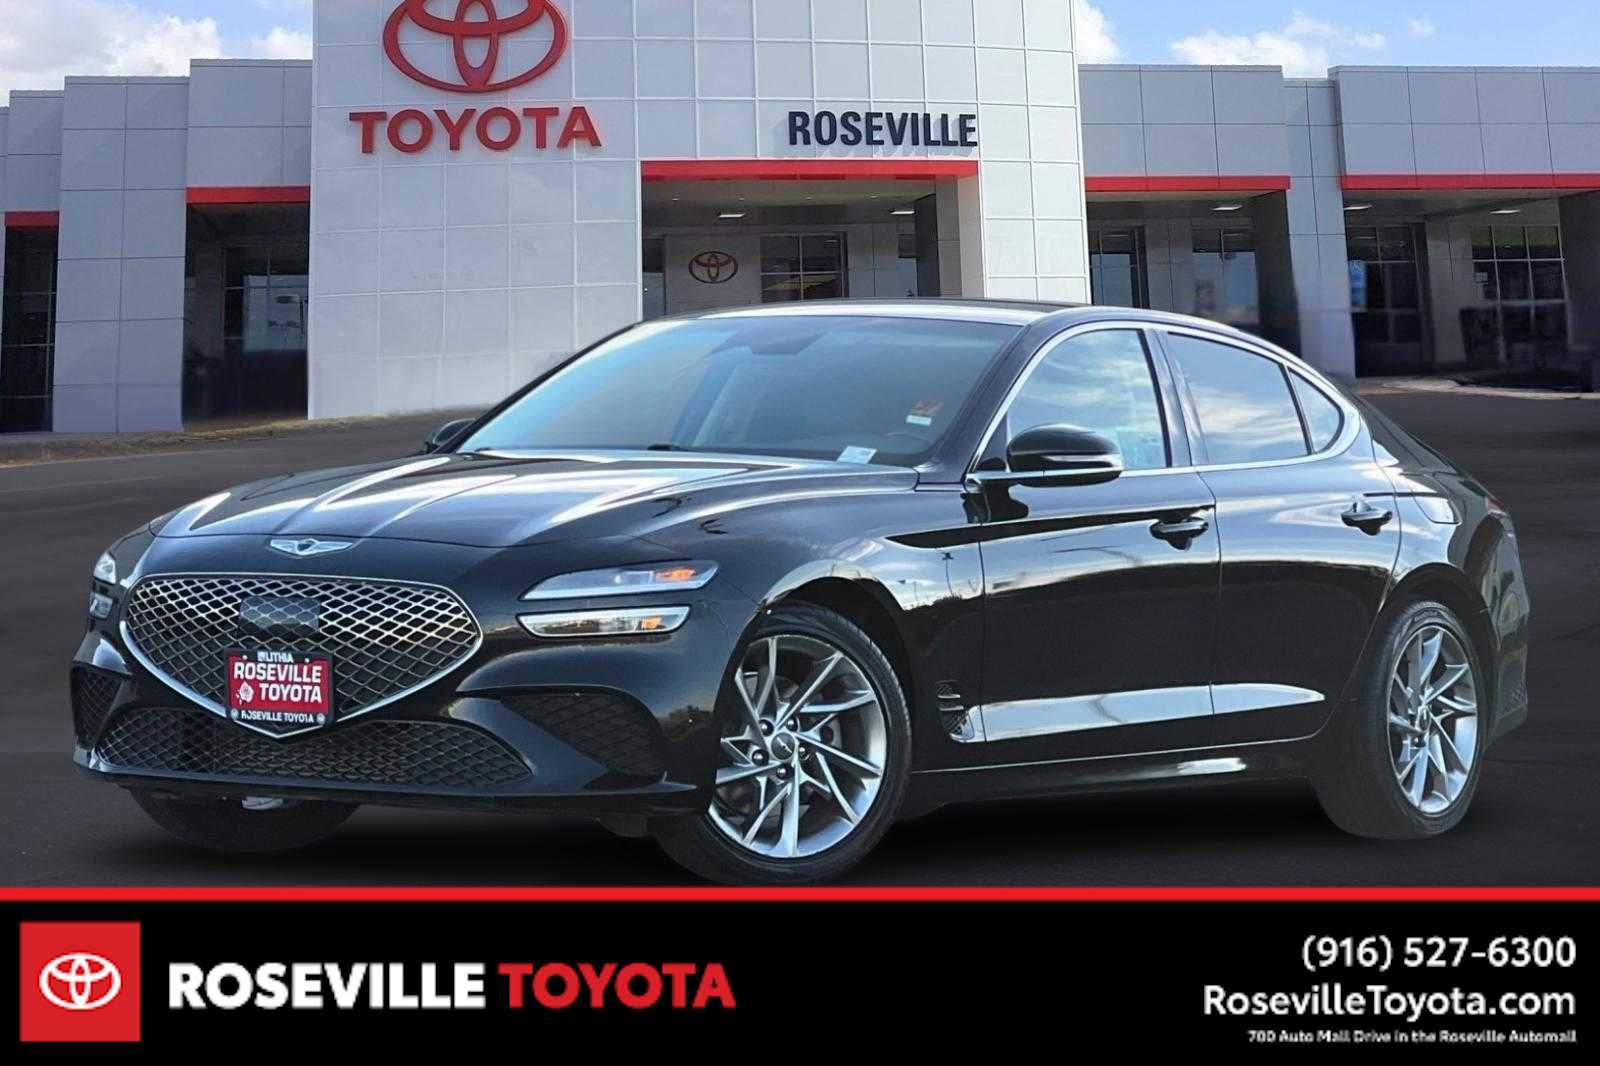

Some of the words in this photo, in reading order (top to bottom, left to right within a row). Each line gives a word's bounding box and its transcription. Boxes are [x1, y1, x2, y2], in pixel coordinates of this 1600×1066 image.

[349, 105, 603, 154] TOYOTA
[788, 110, 979, 147] ROSEVILLE
[233, 661, 323, 684] ROSEVILLE
[259, 682, 323, 704] TOYOTA
[241, 710, 282, 721] ROSEVILLE
[284, 712, 314, 723] TOYOTA
